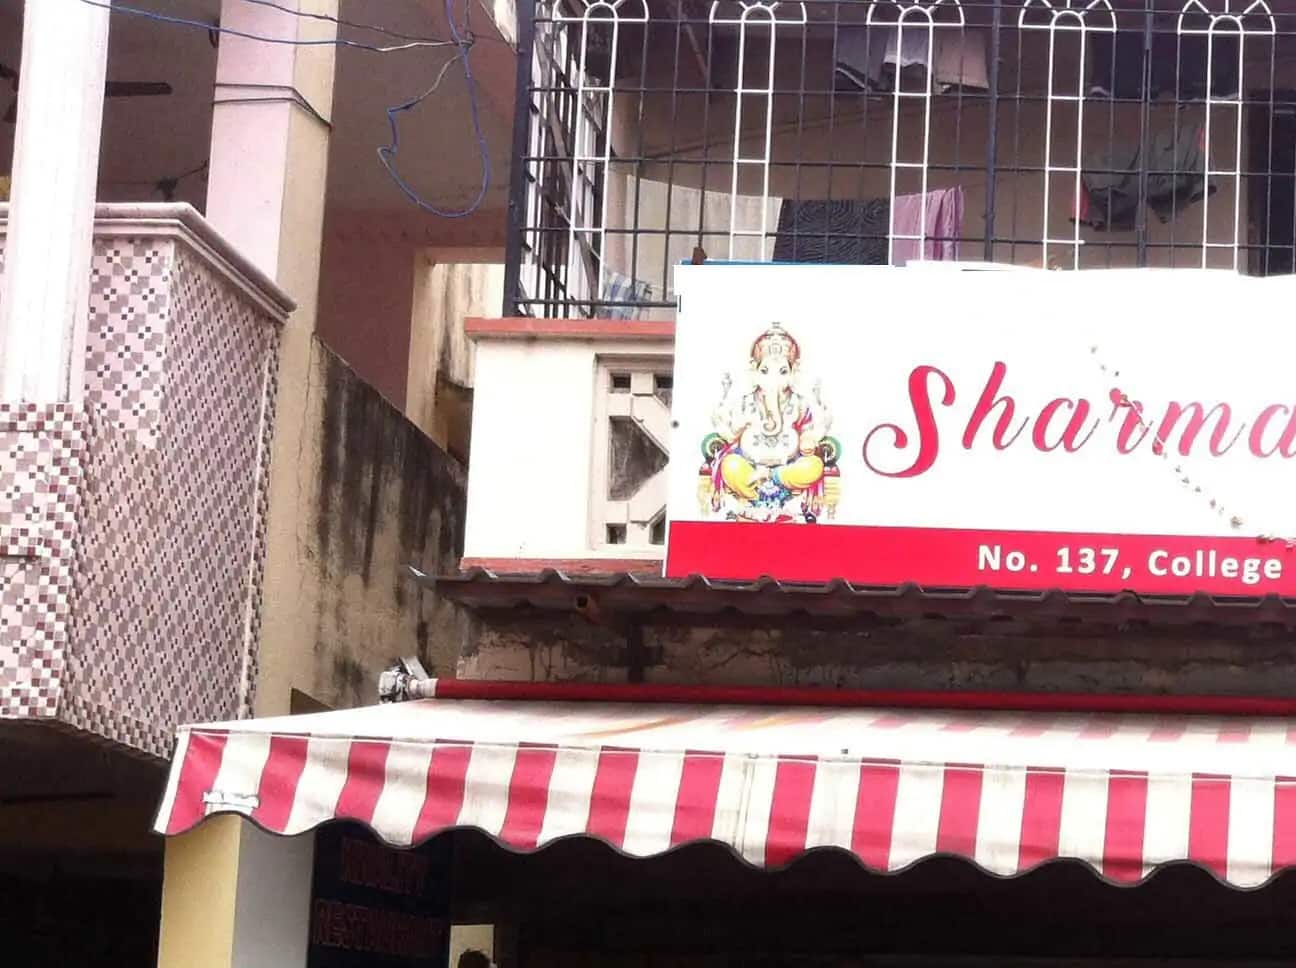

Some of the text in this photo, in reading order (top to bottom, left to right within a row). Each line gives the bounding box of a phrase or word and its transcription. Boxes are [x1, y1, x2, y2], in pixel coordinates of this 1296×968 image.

[977, 545, 1038, 572] No.
[1056, 547, 1132, 579] 137,
[1148, 550, 1281, 585] College
